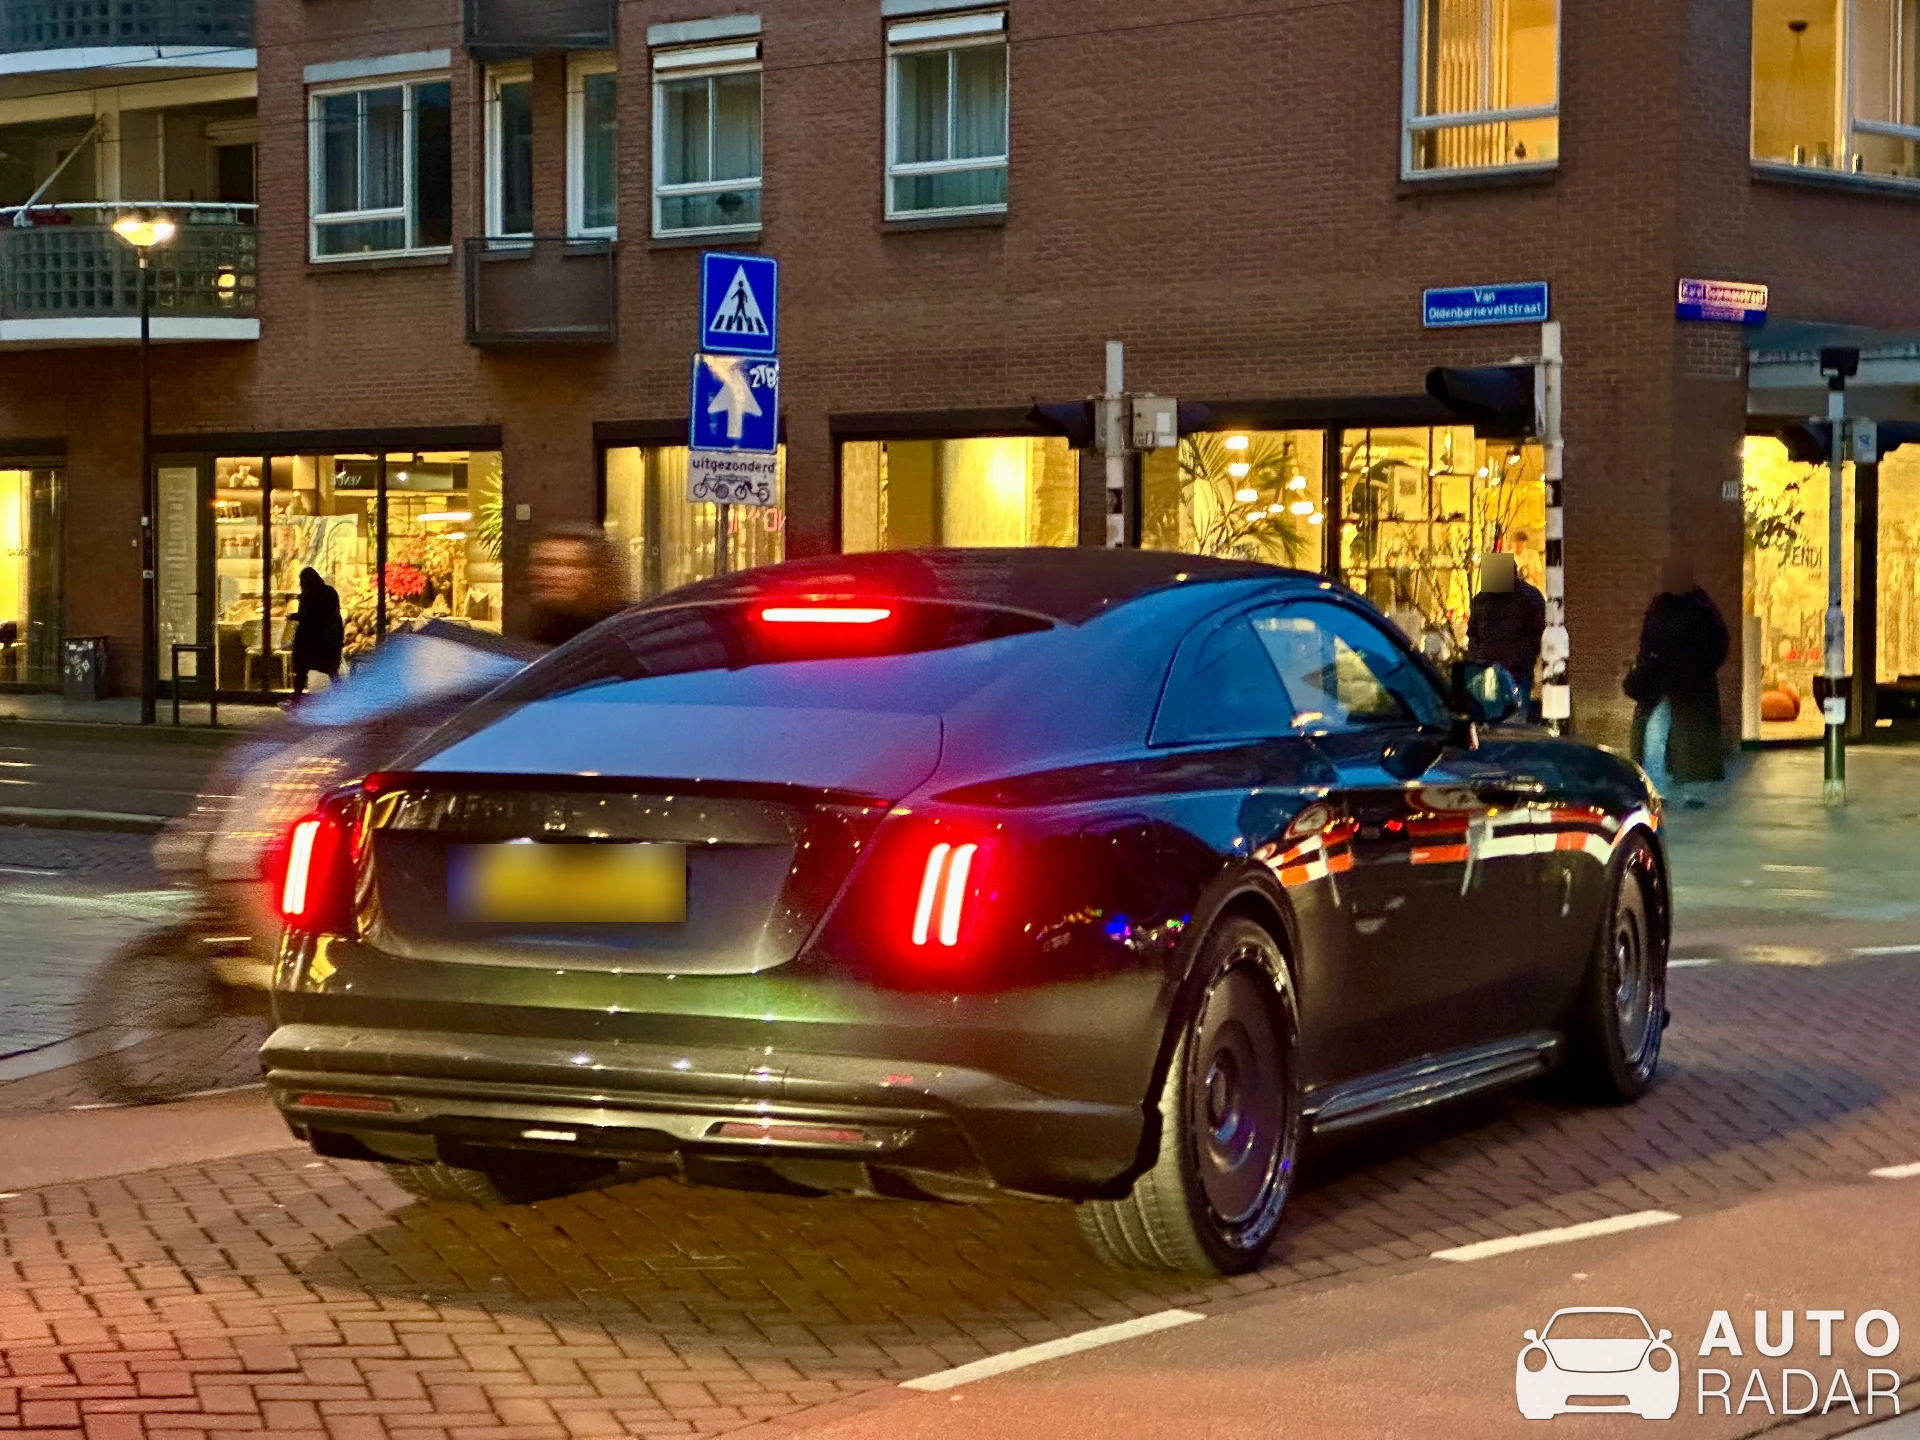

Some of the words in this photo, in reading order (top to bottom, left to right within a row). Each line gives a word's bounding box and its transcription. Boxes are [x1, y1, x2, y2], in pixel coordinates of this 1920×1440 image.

[1474, 289, 1496, 303] Van
[1428, 302, 1542, 320] Oldenbarneveltstraat
[692, 455, 776, 474] uitgezonderd
